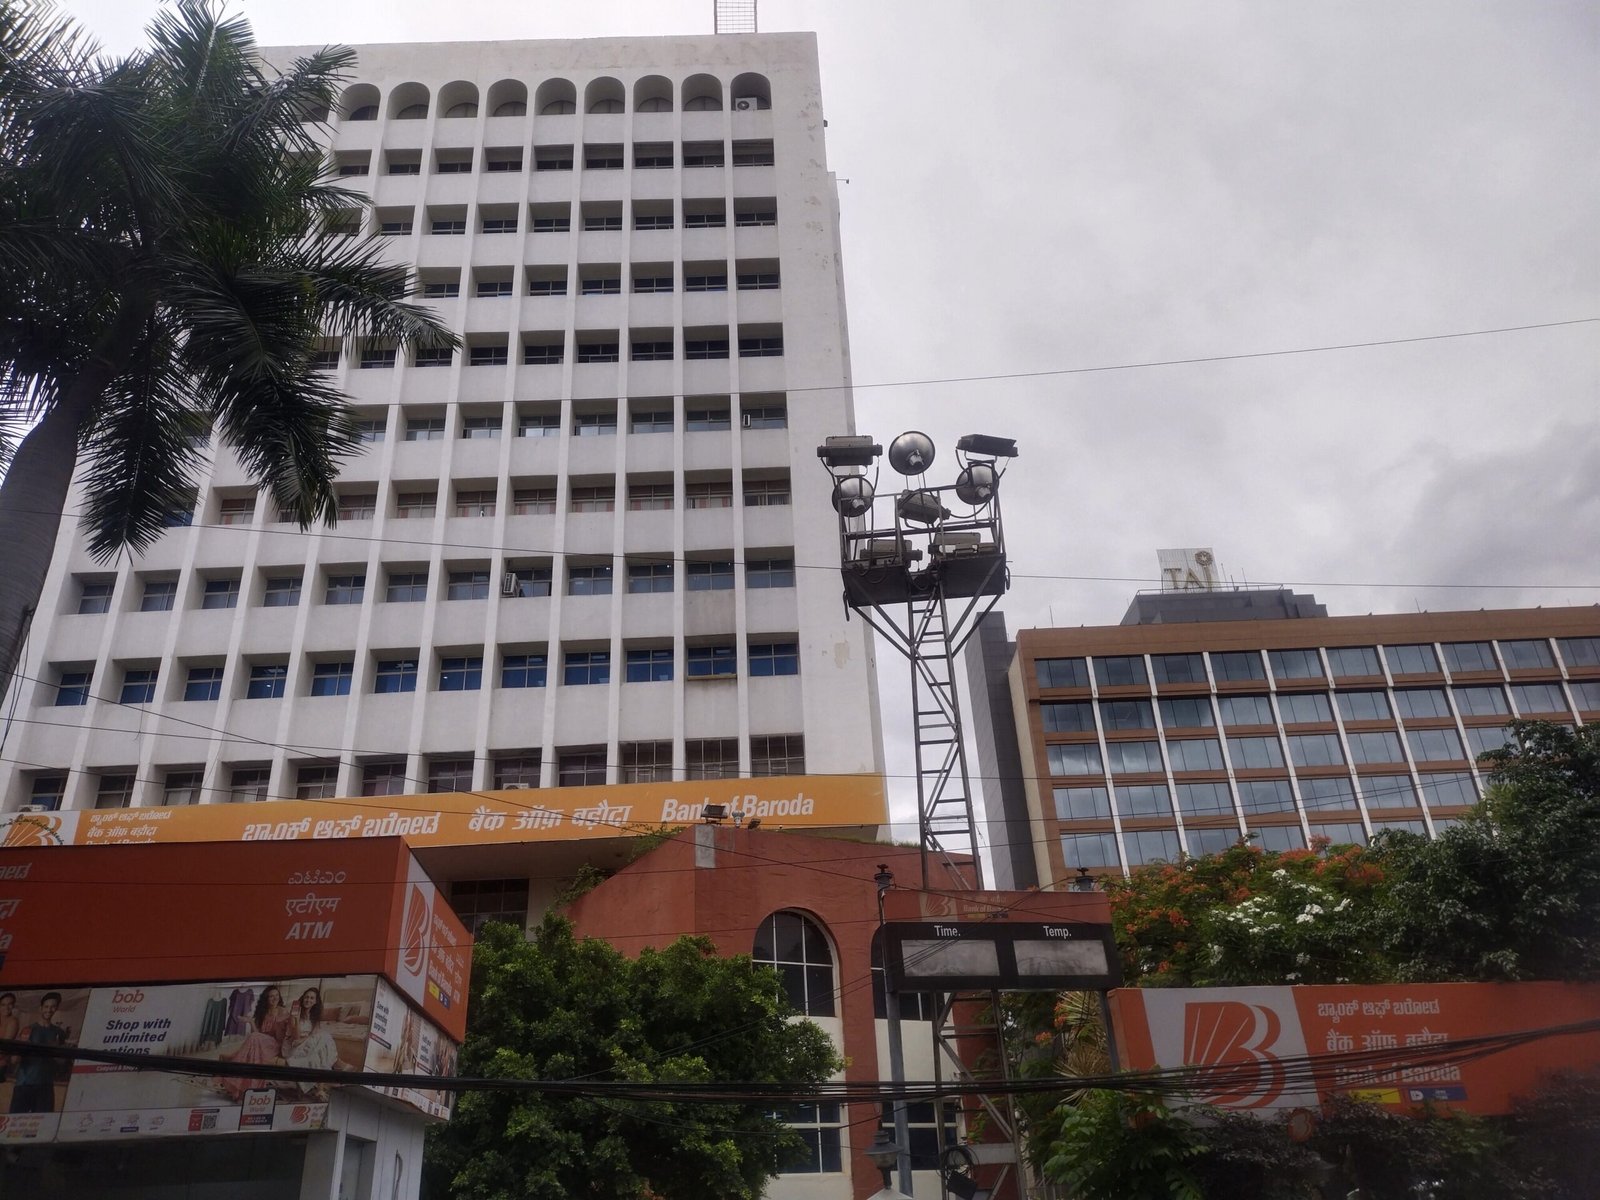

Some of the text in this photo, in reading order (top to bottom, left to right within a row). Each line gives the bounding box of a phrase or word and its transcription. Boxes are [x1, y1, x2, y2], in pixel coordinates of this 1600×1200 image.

[742, 793, 814, 818] Baroda
[468, 804, 507, 832] बैंक
[571, 799, 633, 830] बड़ौदा
[285, 892, 342, 917] एटीएम
[284, 920, 334, 941] ATM
[934, 925, 961, 937] Time.
[1043, 925, 1072, 939] Temp.
[112, 989, 144, 1003] bob
[113, 1005, 136, 1013] World
[106, 1018, 172, 1031] Shop with
[103, 1032, 167, 1044] unlimited
[248, 1094, 271, 1105] bob
